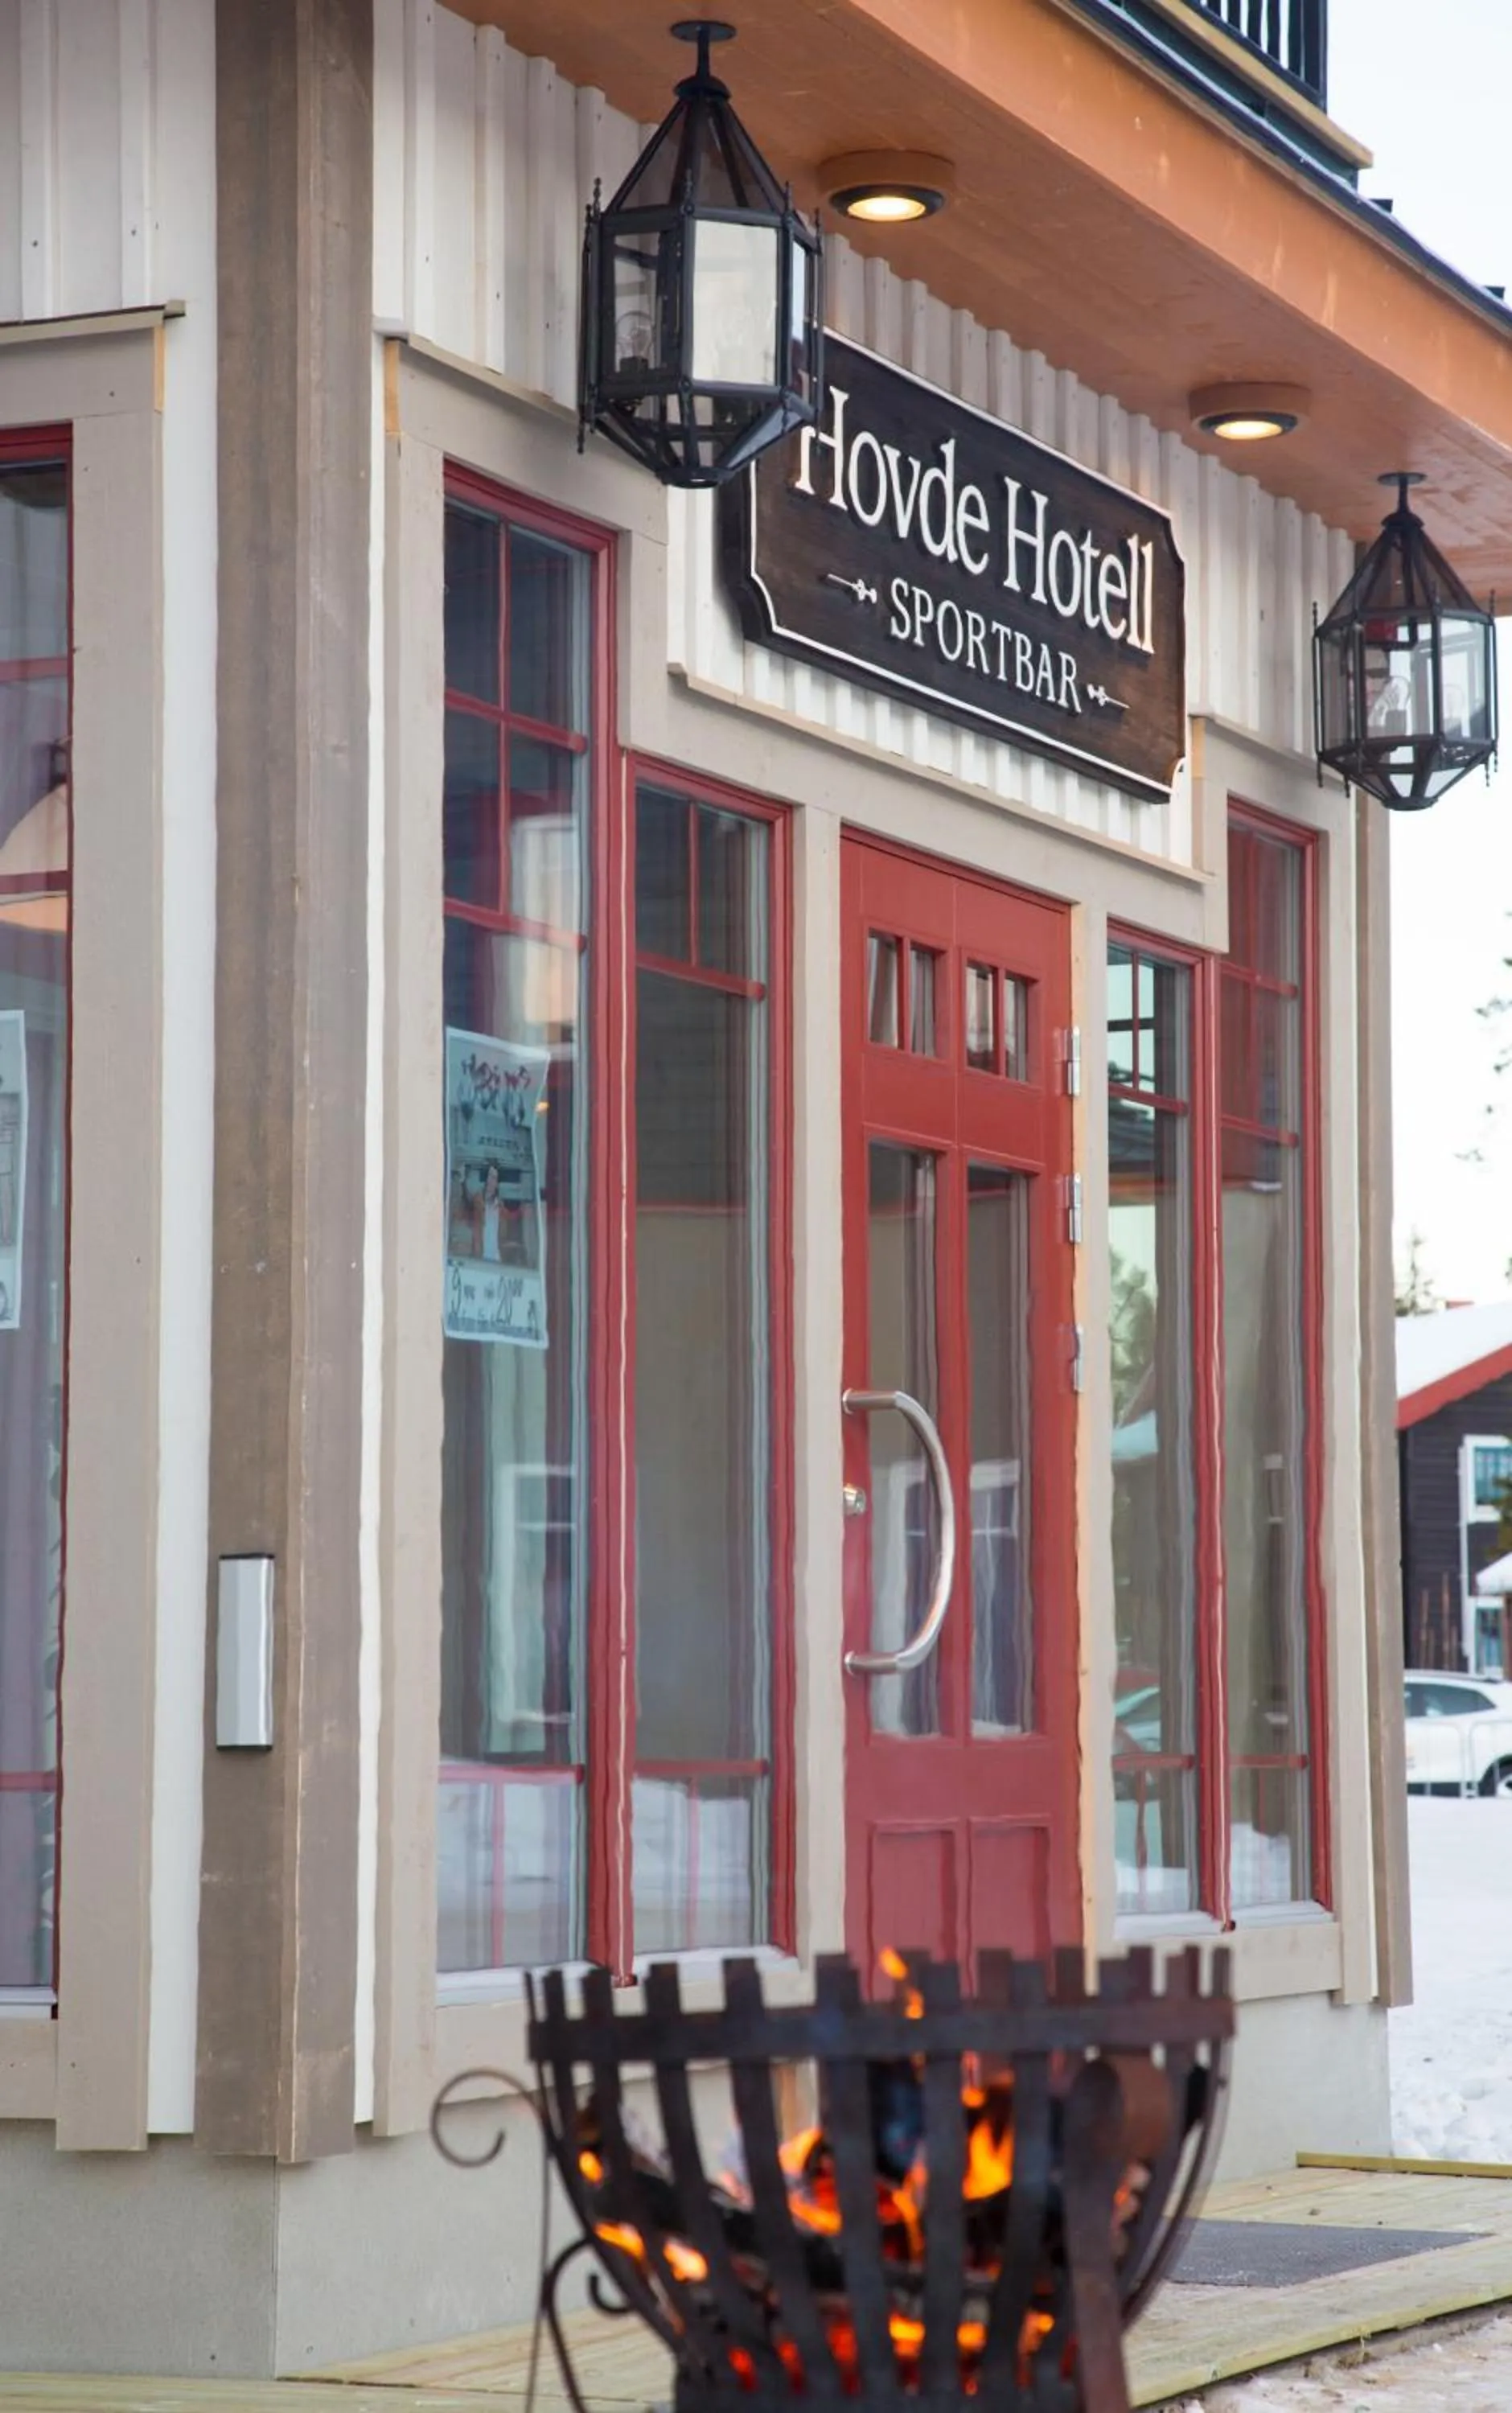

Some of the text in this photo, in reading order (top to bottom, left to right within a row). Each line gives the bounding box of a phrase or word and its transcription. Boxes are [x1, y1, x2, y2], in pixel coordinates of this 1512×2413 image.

[795, 386, 1154, 655] Hovde Hotell
[890, 578, 1081, 713] SPORTBAR
